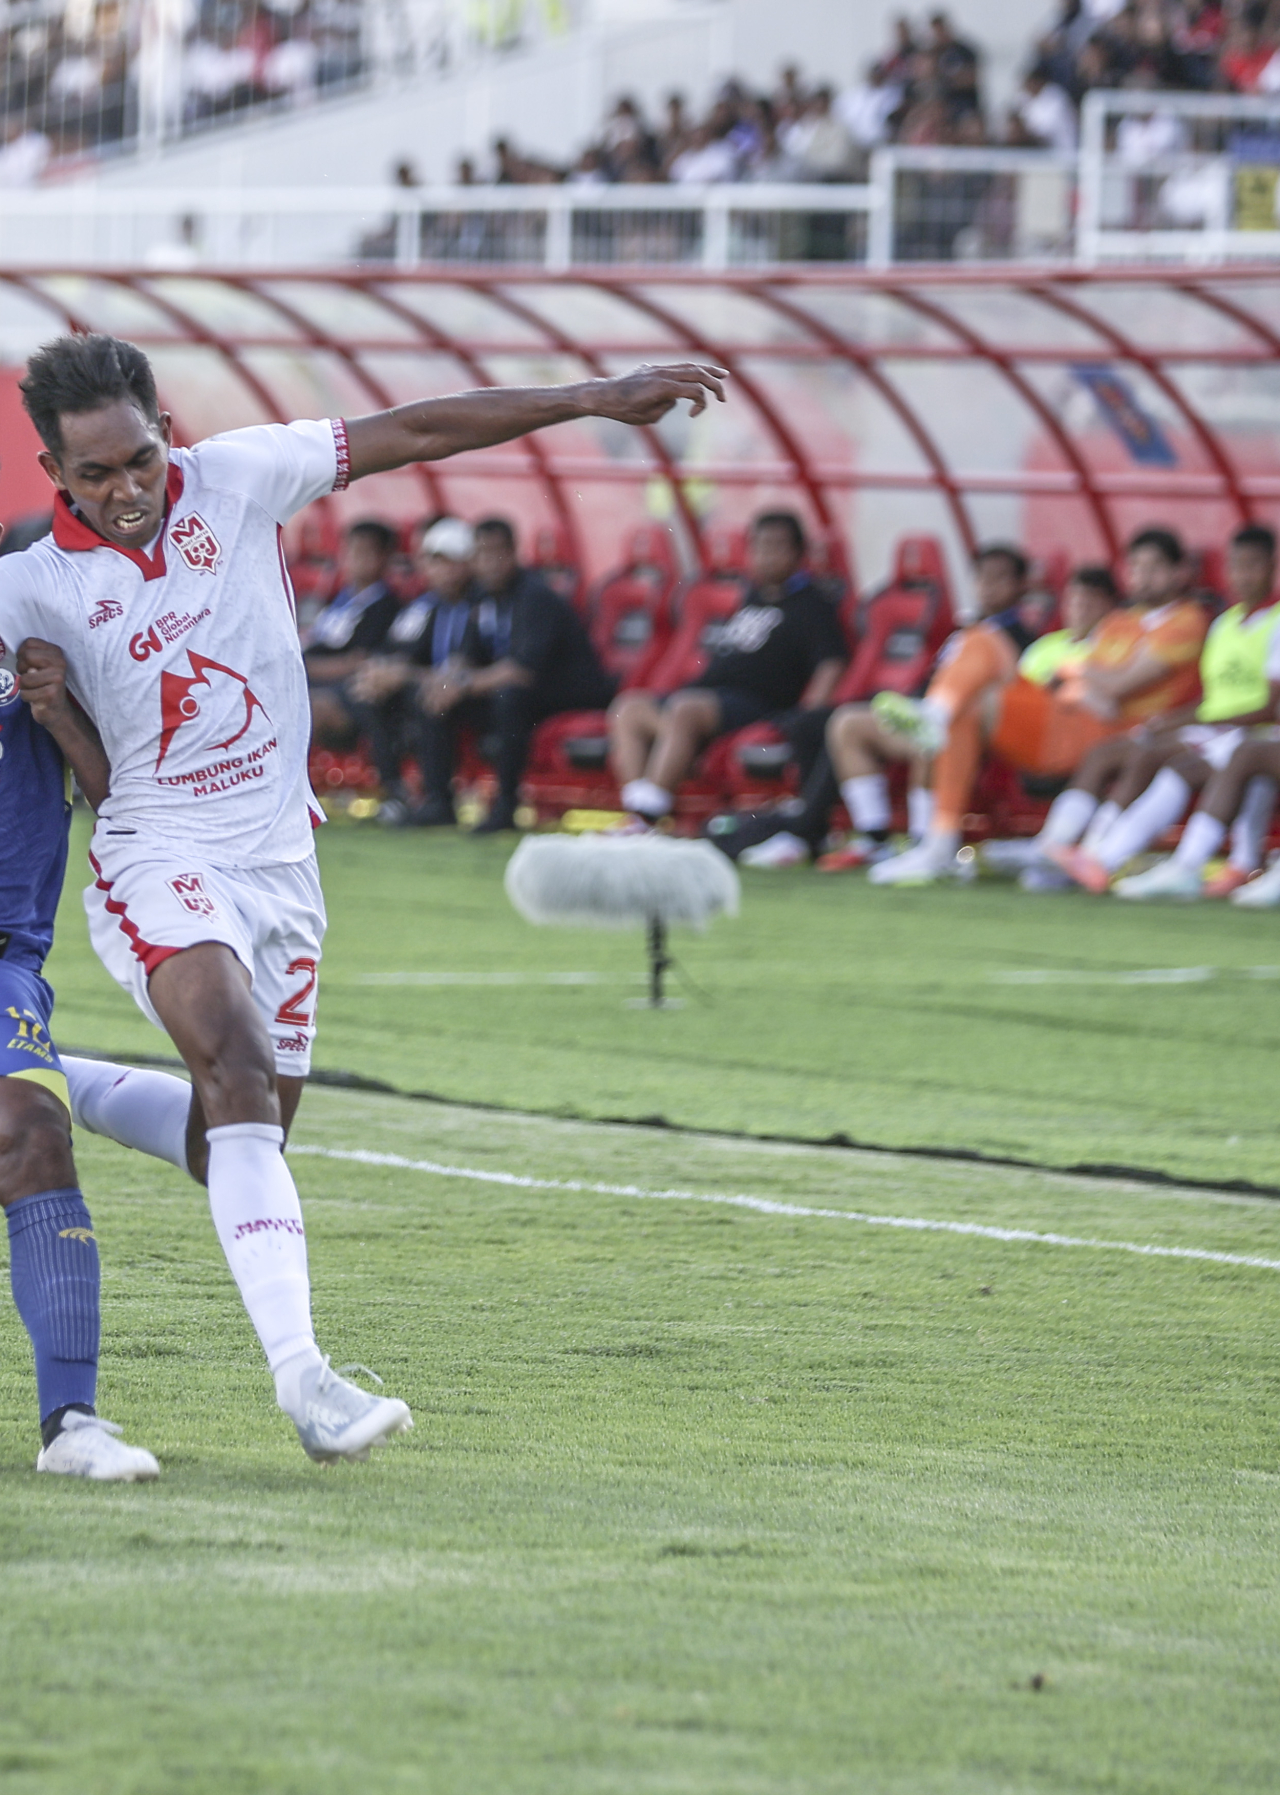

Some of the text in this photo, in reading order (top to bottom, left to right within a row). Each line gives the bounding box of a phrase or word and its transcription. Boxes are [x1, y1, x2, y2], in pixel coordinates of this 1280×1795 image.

[89, 605, 124, 630] SPECS
[155, 611, 177, 629] BPR
[160, 612, 191, 636] Global
[164, 608, 211, 644] Nusantara
[157, 737, 278, 785] LUMBUNG IKAN
[193, 765, 265, 797] MALUKU
[275, 956, 318, 1027] 2
